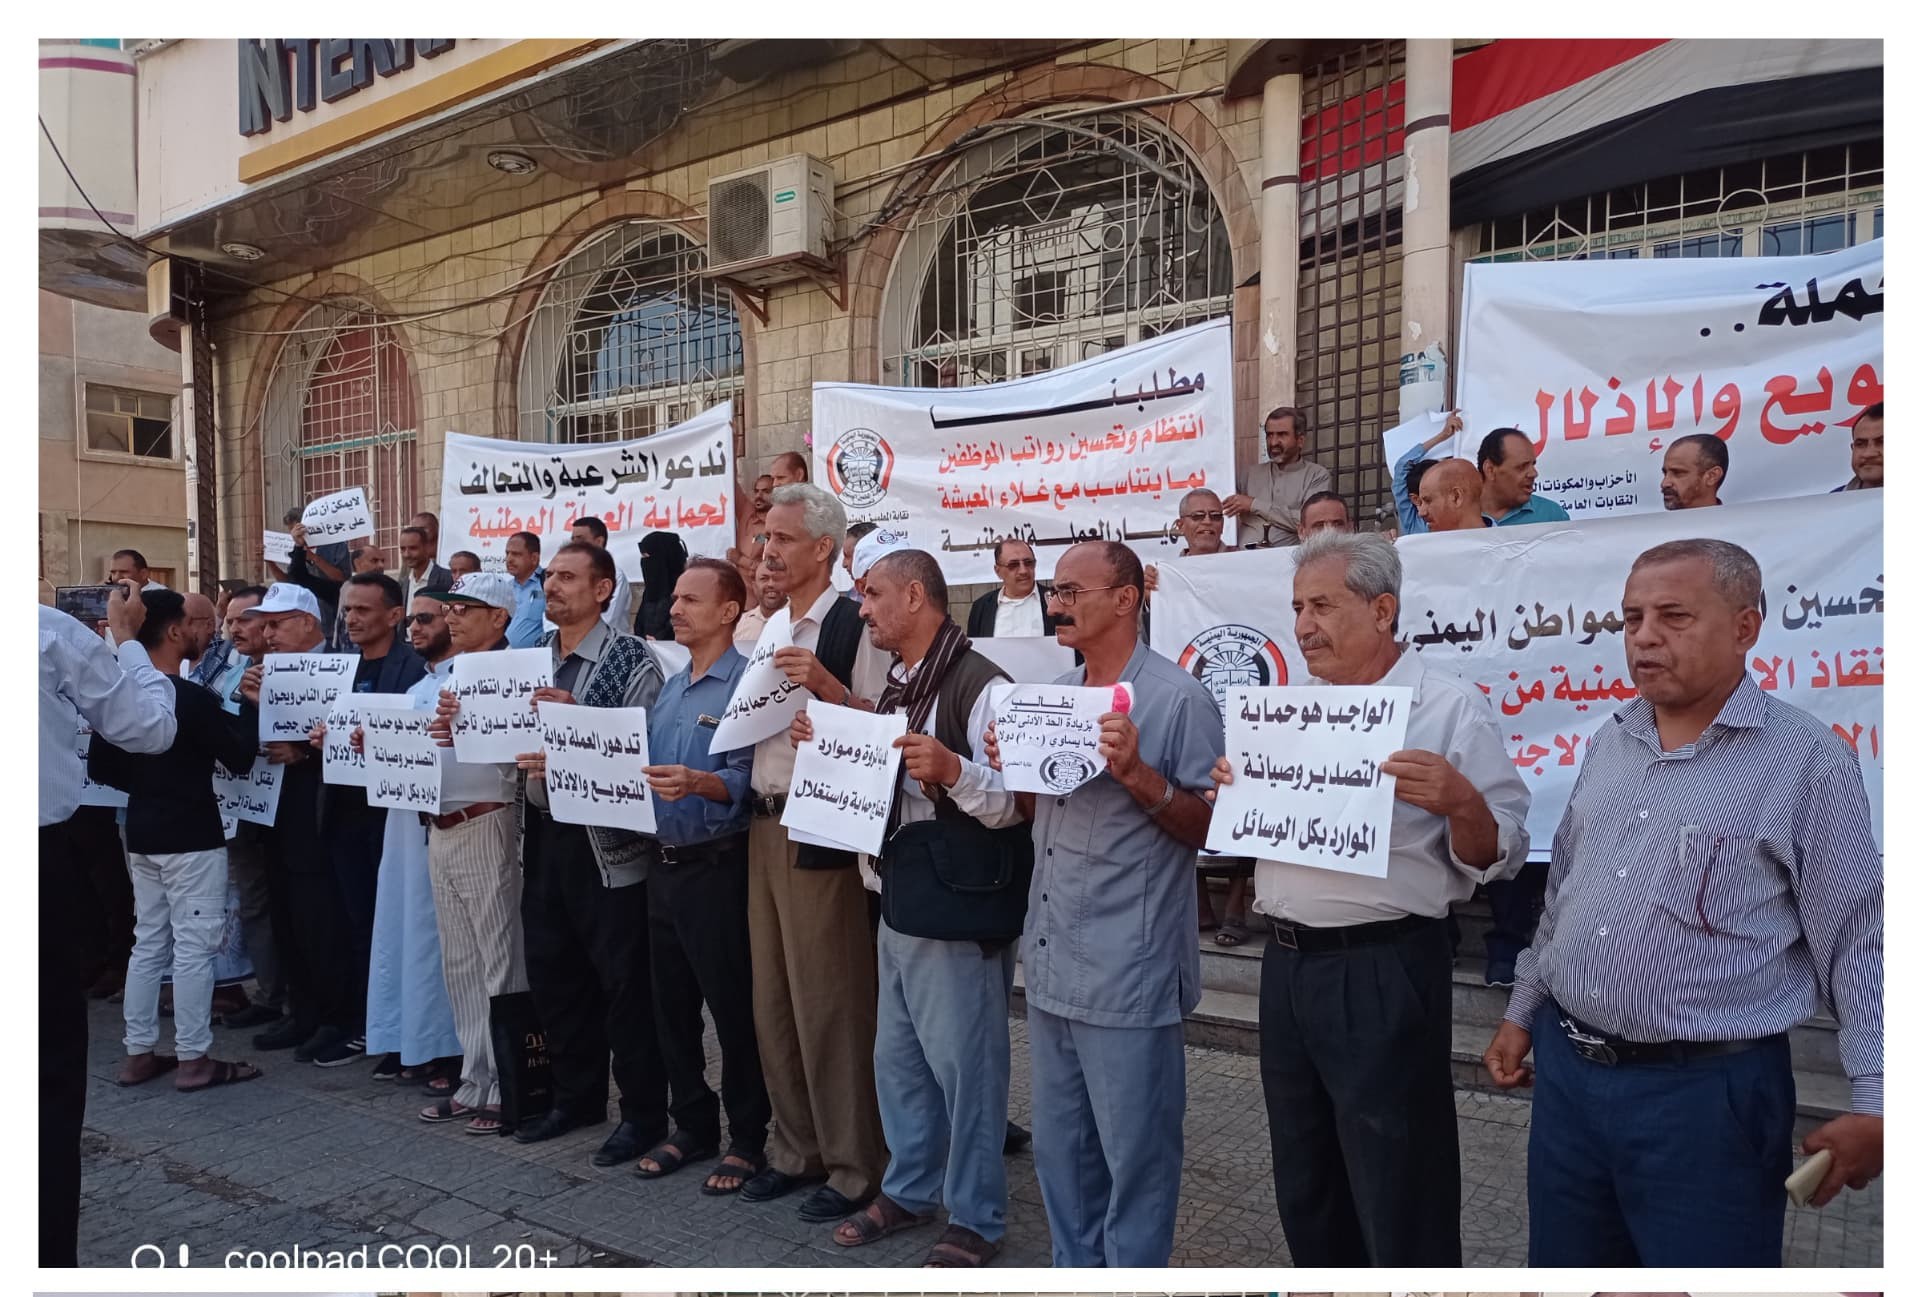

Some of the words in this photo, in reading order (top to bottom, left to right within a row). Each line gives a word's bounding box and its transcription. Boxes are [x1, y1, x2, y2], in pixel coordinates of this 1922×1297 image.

[1760, 364, 1884, 445] ويع
[1069, 423, 1137, 460] وتحسين
[1141, 413, 1205, 452] انتظام
[660, 441, 726, 490] ندعو
[938, 440, 1005, 473] الموظفين
[1010, 435, 1064, 467] رواتب
[459, 461, 556, 500] والتحالف
[551, 449, 659, 496] الشرعية
[1084, 466, 1162, 503] يتناسب
[1595, 470, 1637, 490] الأحزاب
[937, 483, 994, 514] المعيشة
[999, 477, 1050, 509] غلاء
[1053, 481, 1081, 510] مع
[1595, 494, 1638, 510] النقابات
[468, 505, 554, 548] الوطنية
[563, 501, 633, 532] العلة
[1782, 574, 1884, 631] حسين
[1507, 601, 1625, 651] مواطن
[267, 656, 309, 676] الأسعار
[309, 658, 350, 676] ارتفاع
[296, 687, 320, 706] الناس
[321, 688, 339, 705] قتل
[472, 677, 500, 699] انتظام
[1011, 695, 1074, 711] نطالب
[1501, 671, 1546, 716] من
[739, 695, 770, 717] حماية
[997, 712, 1017, 726] للأجو
[1240, 695, 1298, 731] حماية
[1297, 700, 1323, 731] هو
[1326, 697, 1395, 733] الواجب
[405, 716, 432, 737] لواجب
[481, 715, 508, 735] بدون
[511, 711, 541, 734] رتبات
[543, 722, 567, 752] بوابة
[566, 725, 601, 750] العملة
[999, 729, 1014, 743] دولا
[1066, 717, 1093, 732] بزيادة
[600, 732, 641, 758] تدهور
[818, 737, 862, 764] وموارد
[1049, 734, 1081, 748] يساوي
[1083, 736, 1097, 750] بما
[1241, 751, 1304, 791] وصيانة
[1303, 758, 1382, 794] التصدير
[591, 779, 645, 805] للتجويع
[794, 779, 849, 811] واستغلال
[1231, 808, 1297, 847] الوسائل
[1299, 816, 1328, 854] بكل
[1329, 822, 1376, 859] الموارد
